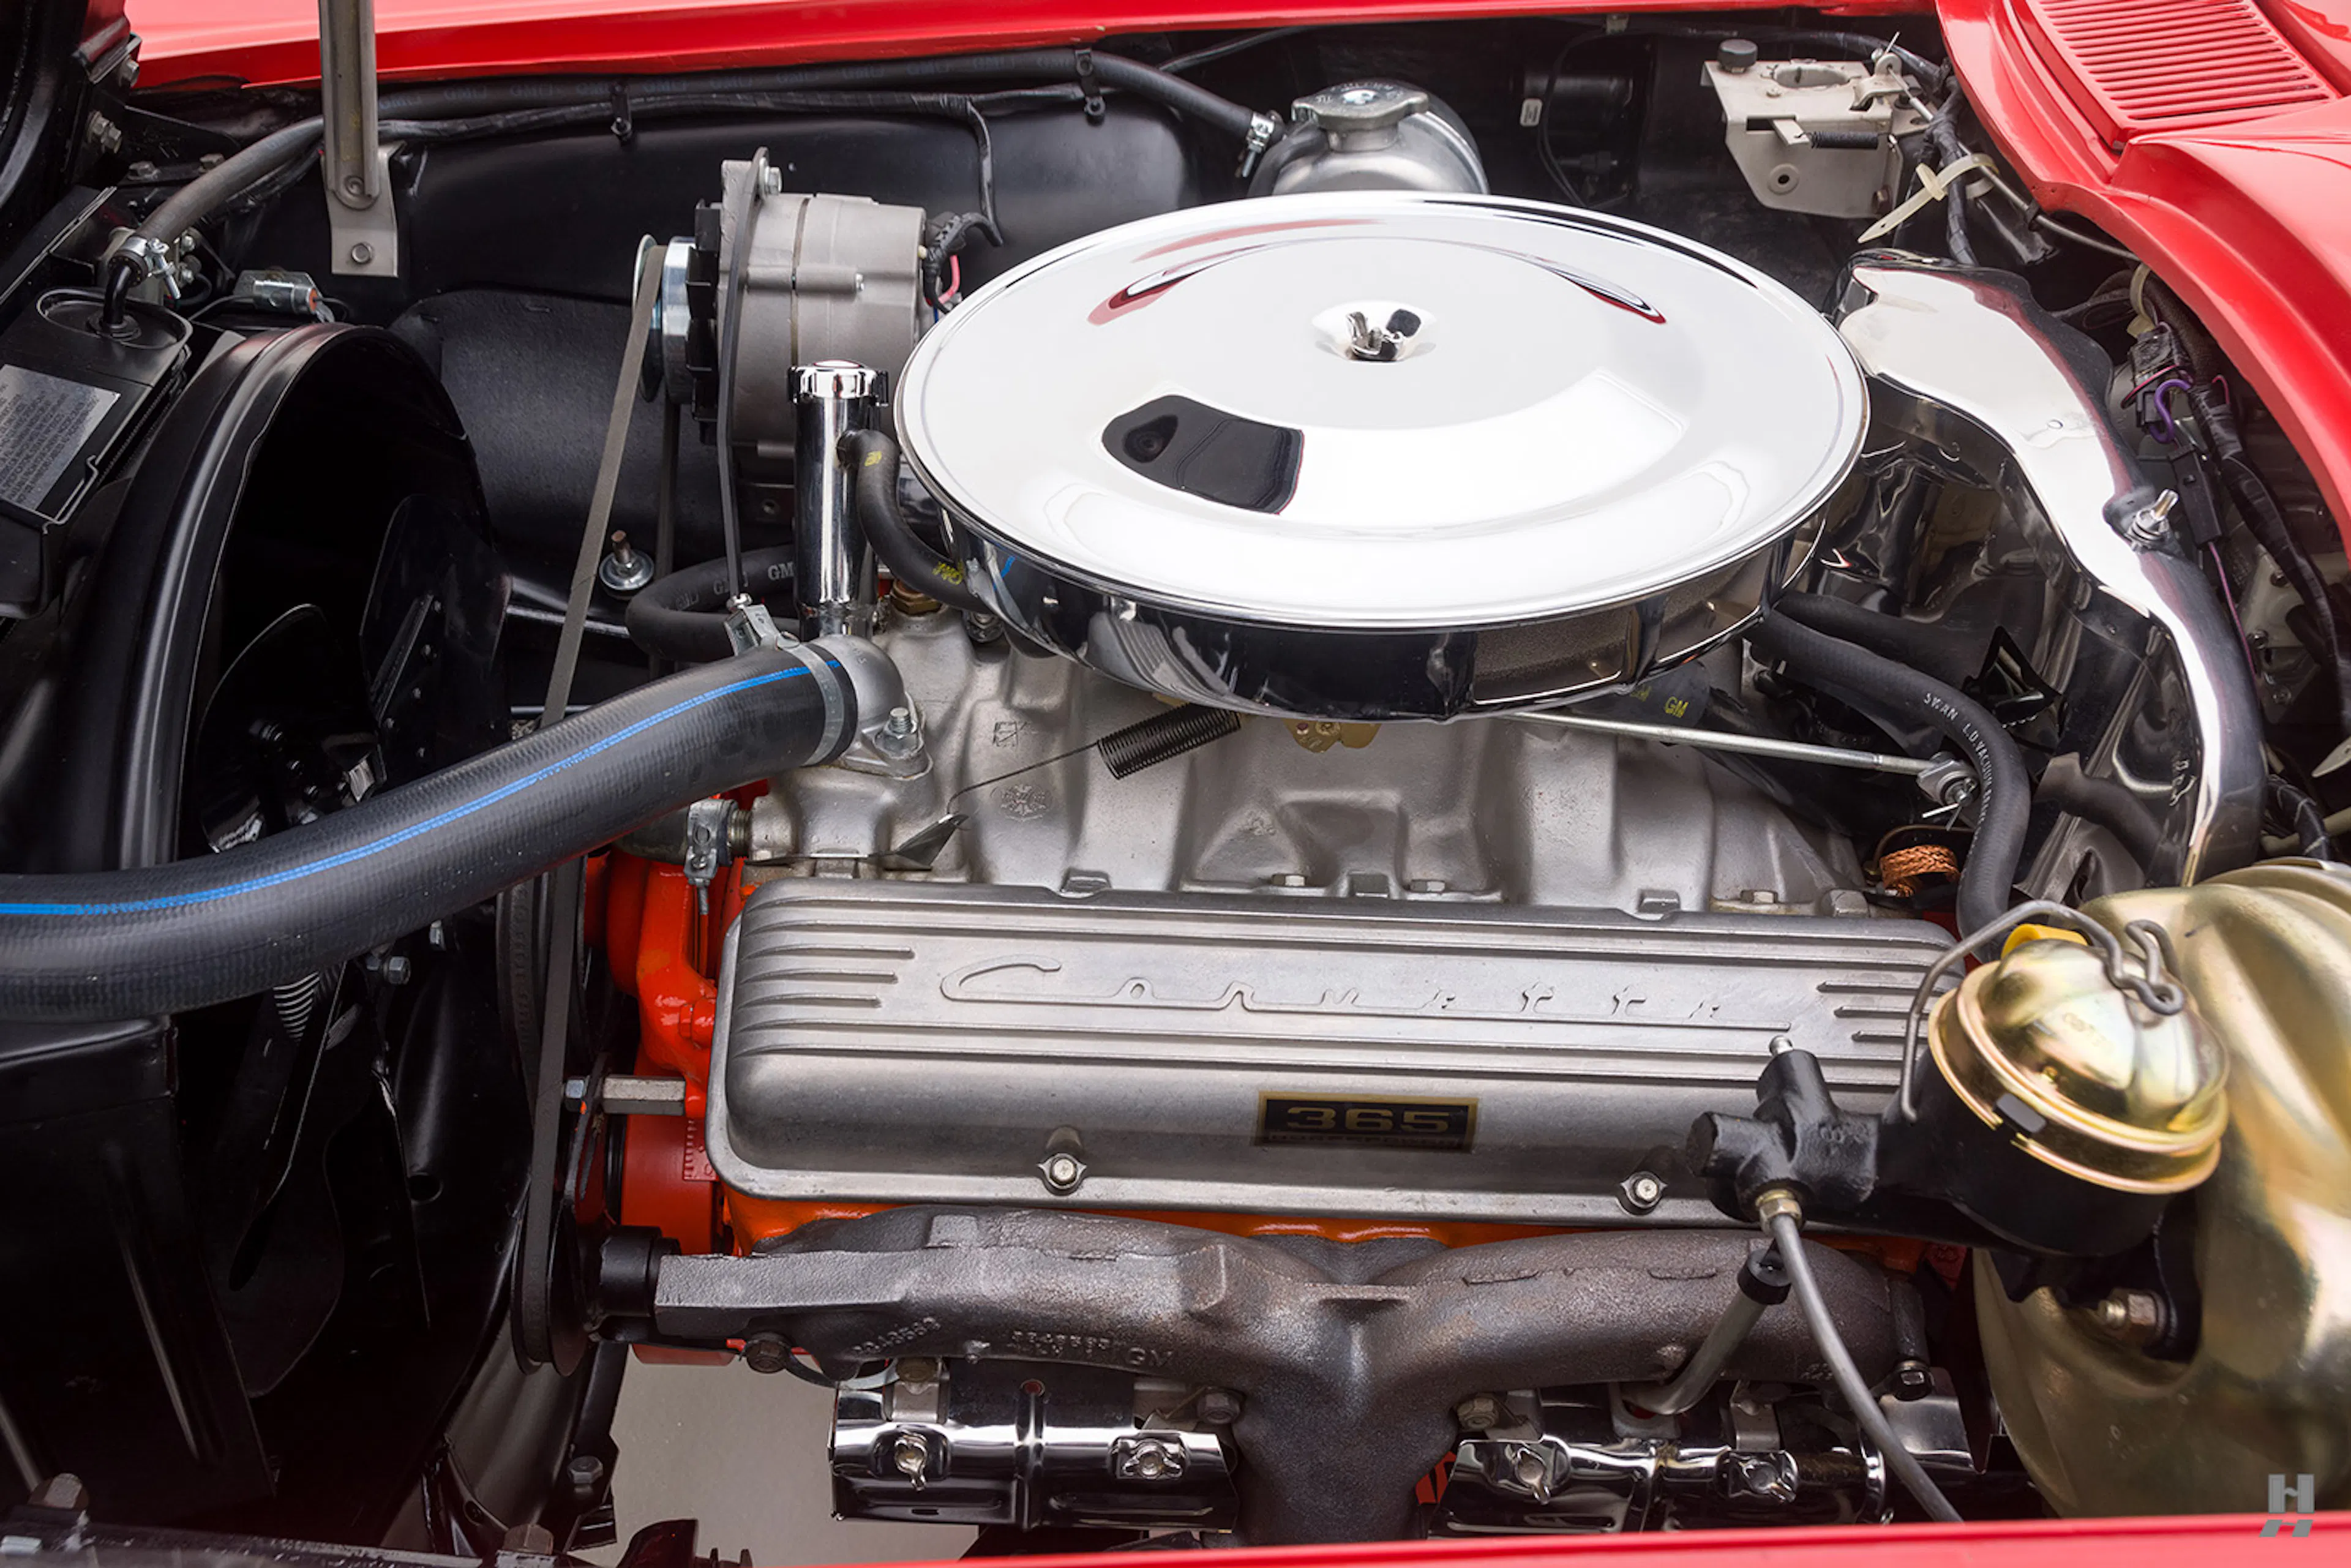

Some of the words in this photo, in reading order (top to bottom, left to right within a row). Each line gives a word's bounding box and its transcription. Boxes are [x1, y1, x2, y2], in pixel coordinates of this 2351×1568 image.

[767, 561, 794, 581] GM
[1664, 696, 1689, 718] GM
[1286, 1106, 1450, 1133] 365
